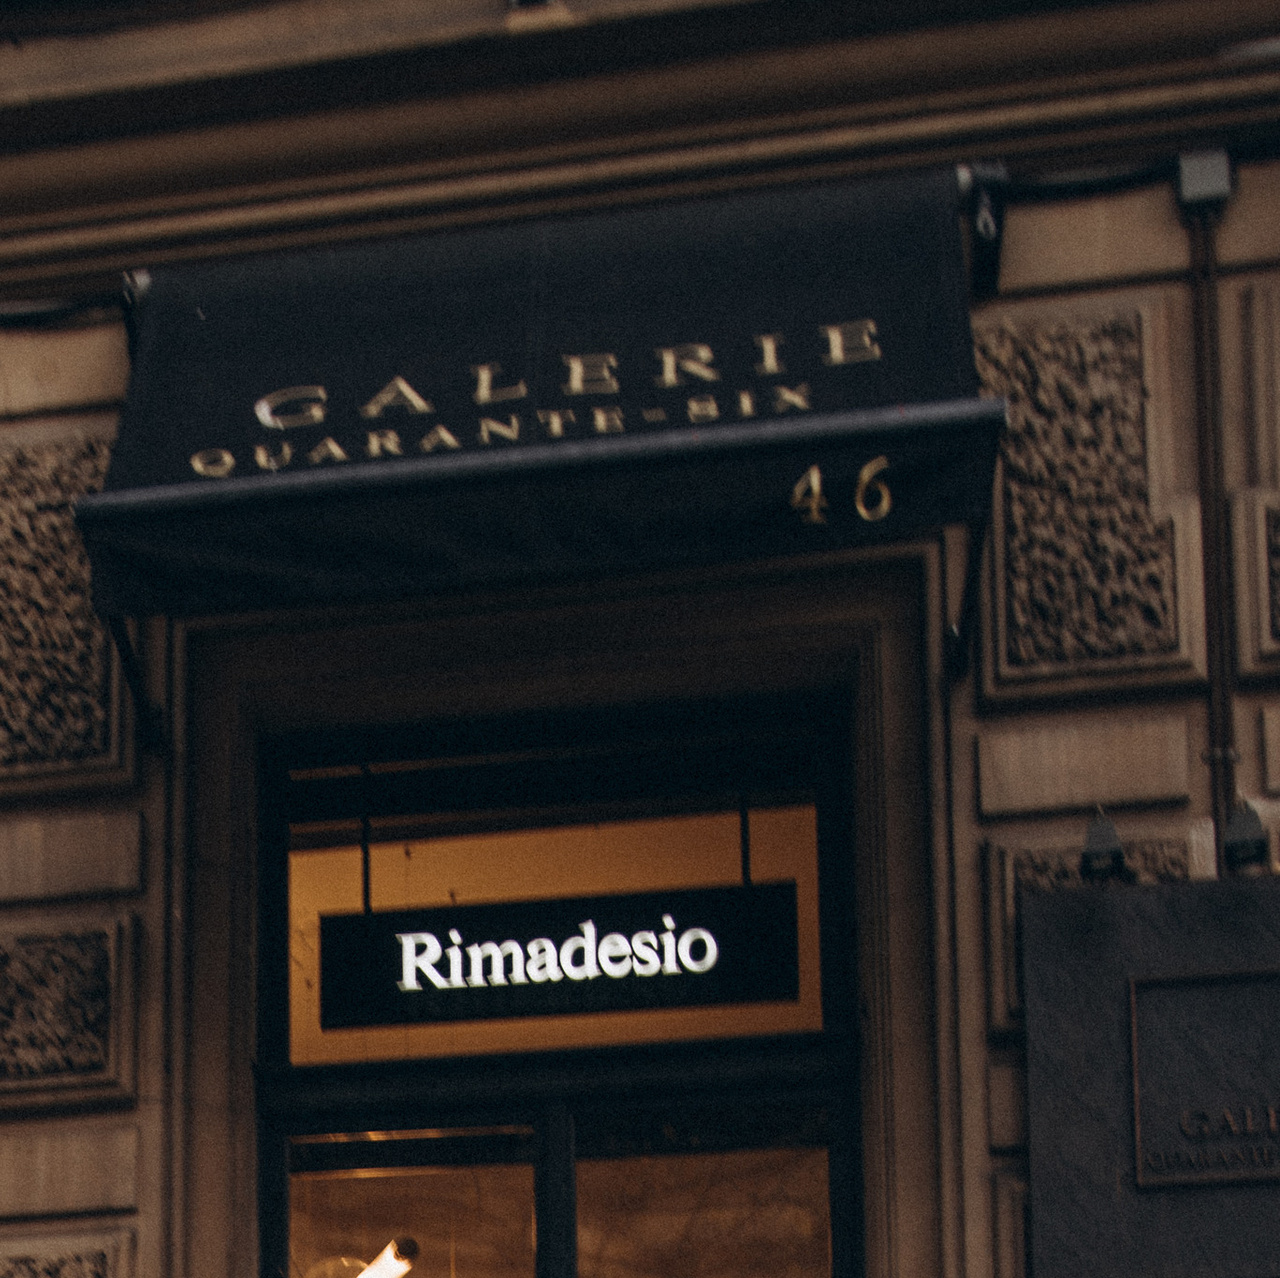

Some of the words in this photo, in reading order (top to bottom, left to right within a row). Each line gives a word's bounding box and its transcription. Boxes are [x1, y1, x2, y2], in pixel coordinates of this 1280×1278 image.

[252, 317, 883, 430] GALERIE
[188, 381, 813, 480] QUARANTE-SIX
[788, 454, 894, 525] 46
[394, 912, 719, 993] Rimadesio
